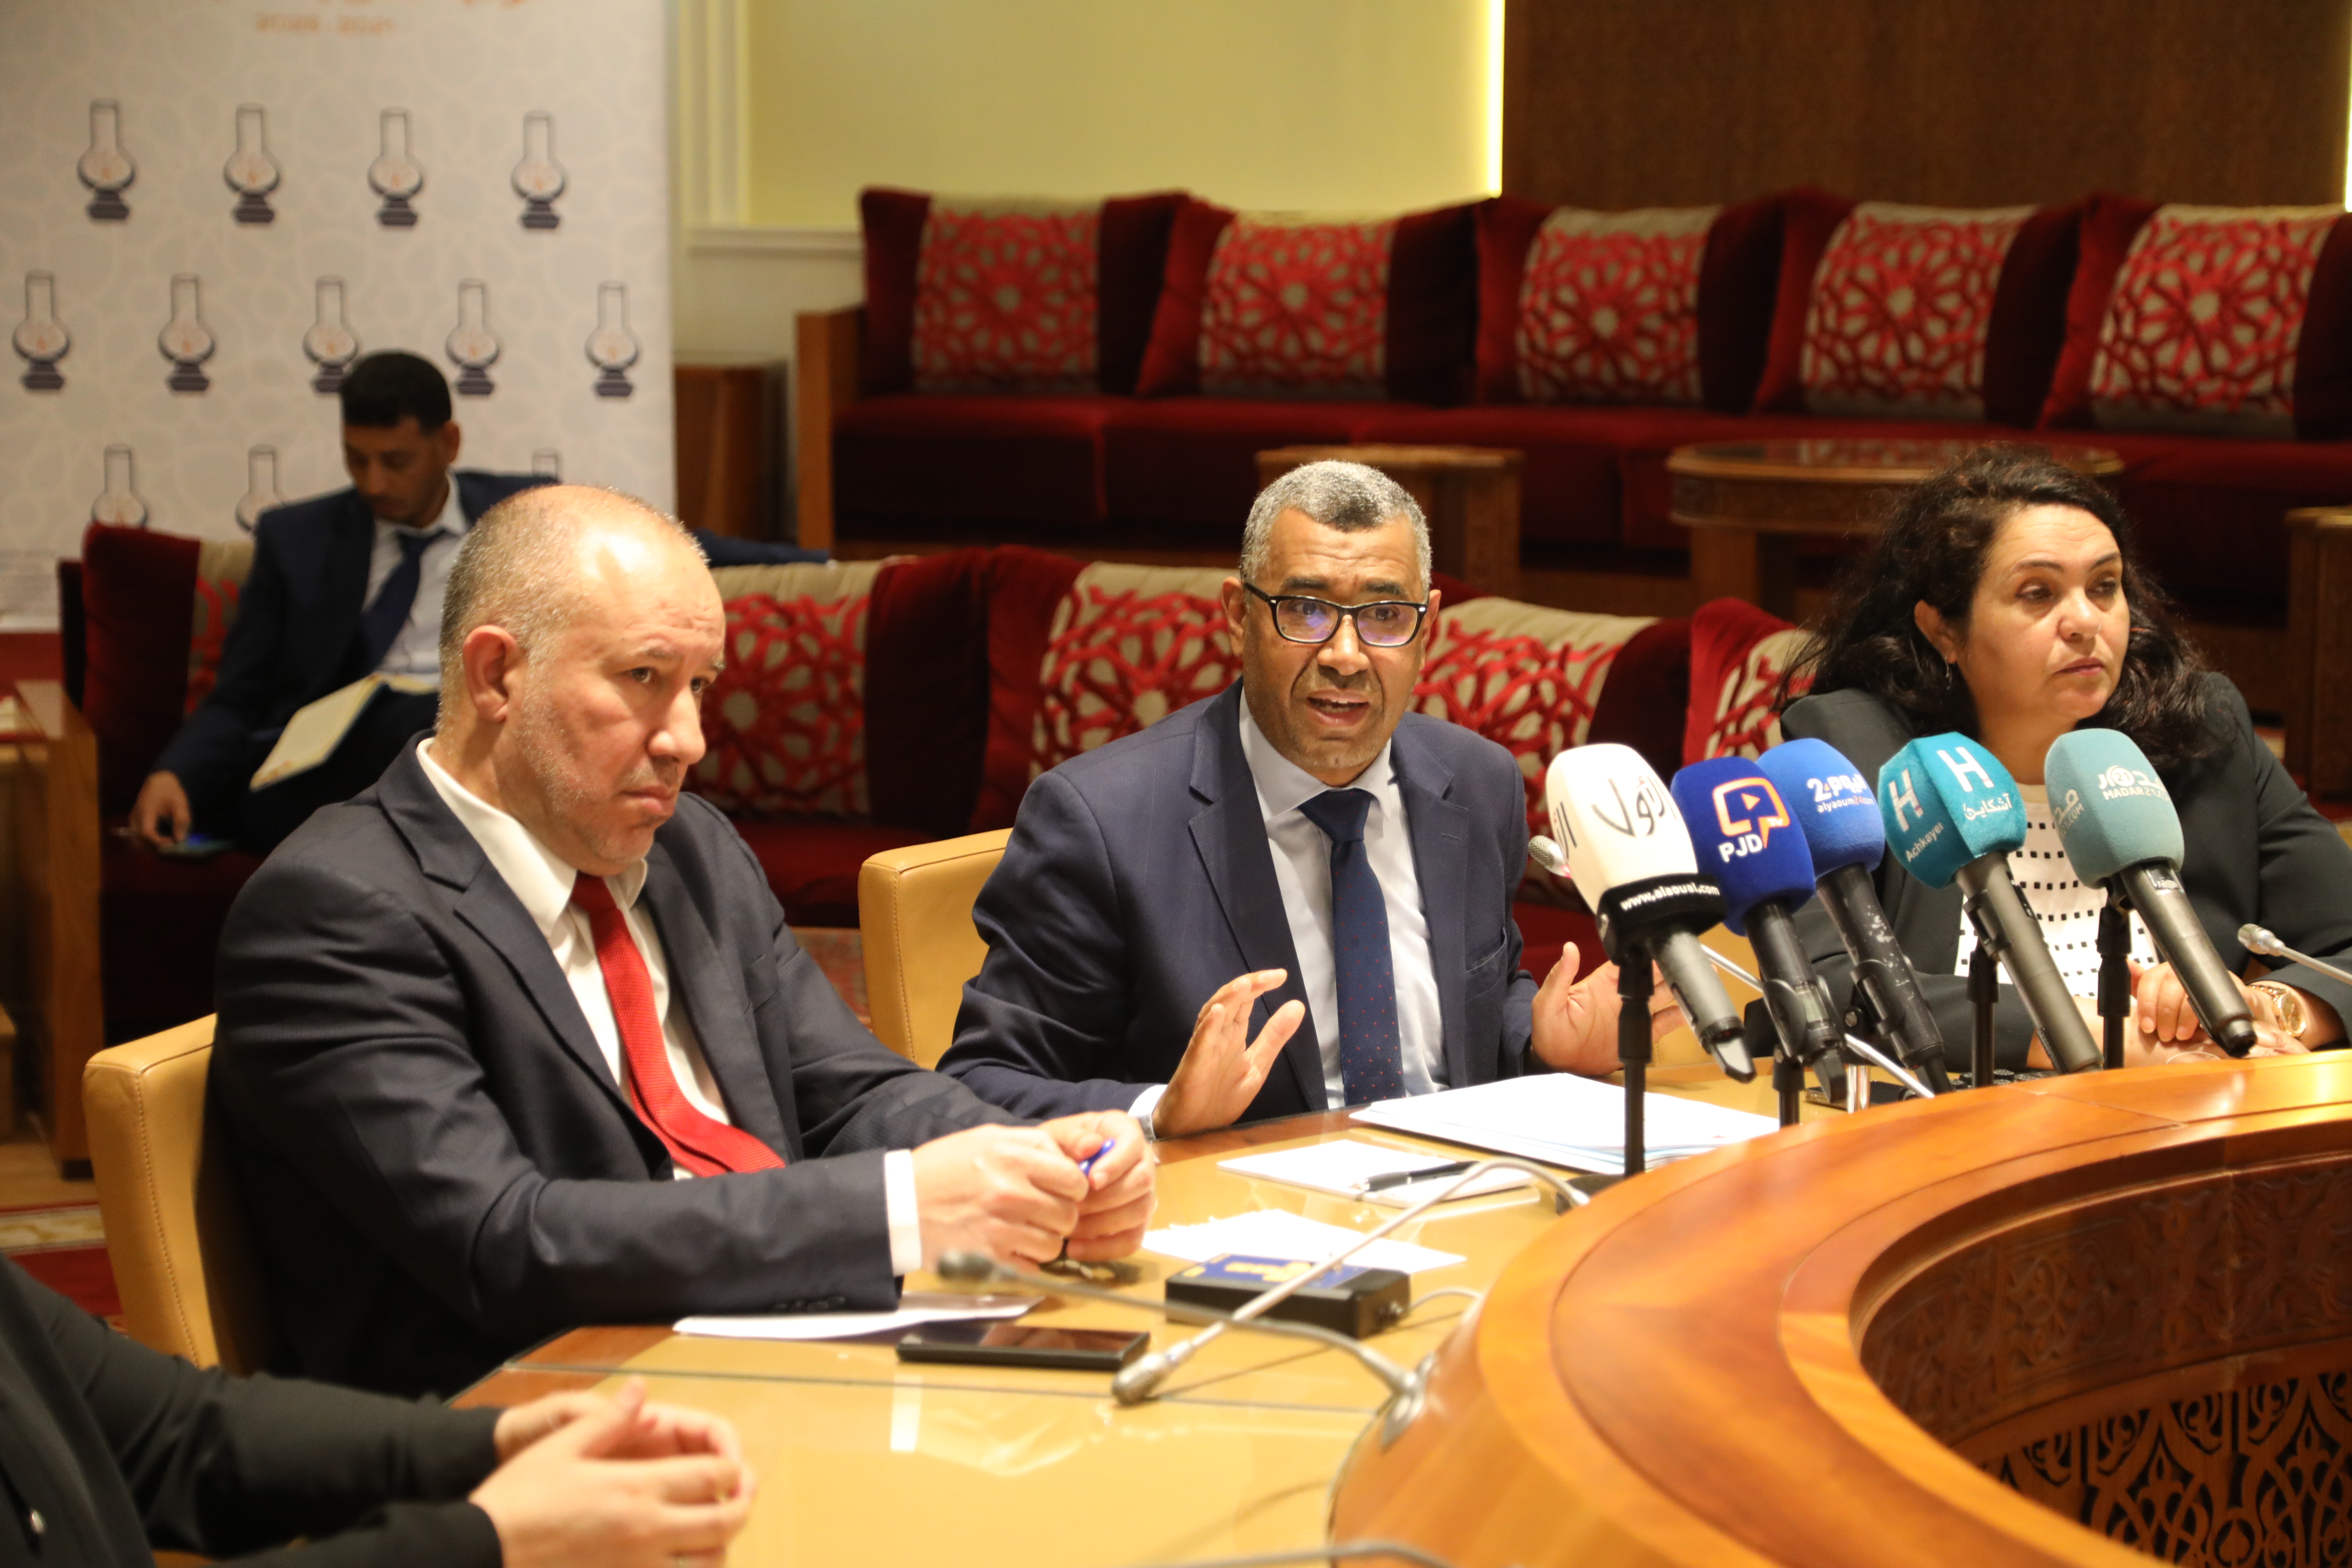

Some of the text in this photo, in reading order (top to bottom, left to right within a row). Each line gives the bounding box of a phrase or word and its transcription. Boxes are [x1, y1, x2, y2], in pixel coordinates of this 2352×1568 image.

[1937, 746, 1994, 792] H
[1888, 768, 1924, 832] H
[1767, 818, 1783, 826] TV
[1718, 834, 1763, 863] PJD
[1620, 882, 1721, 912] www.alaoual.com
